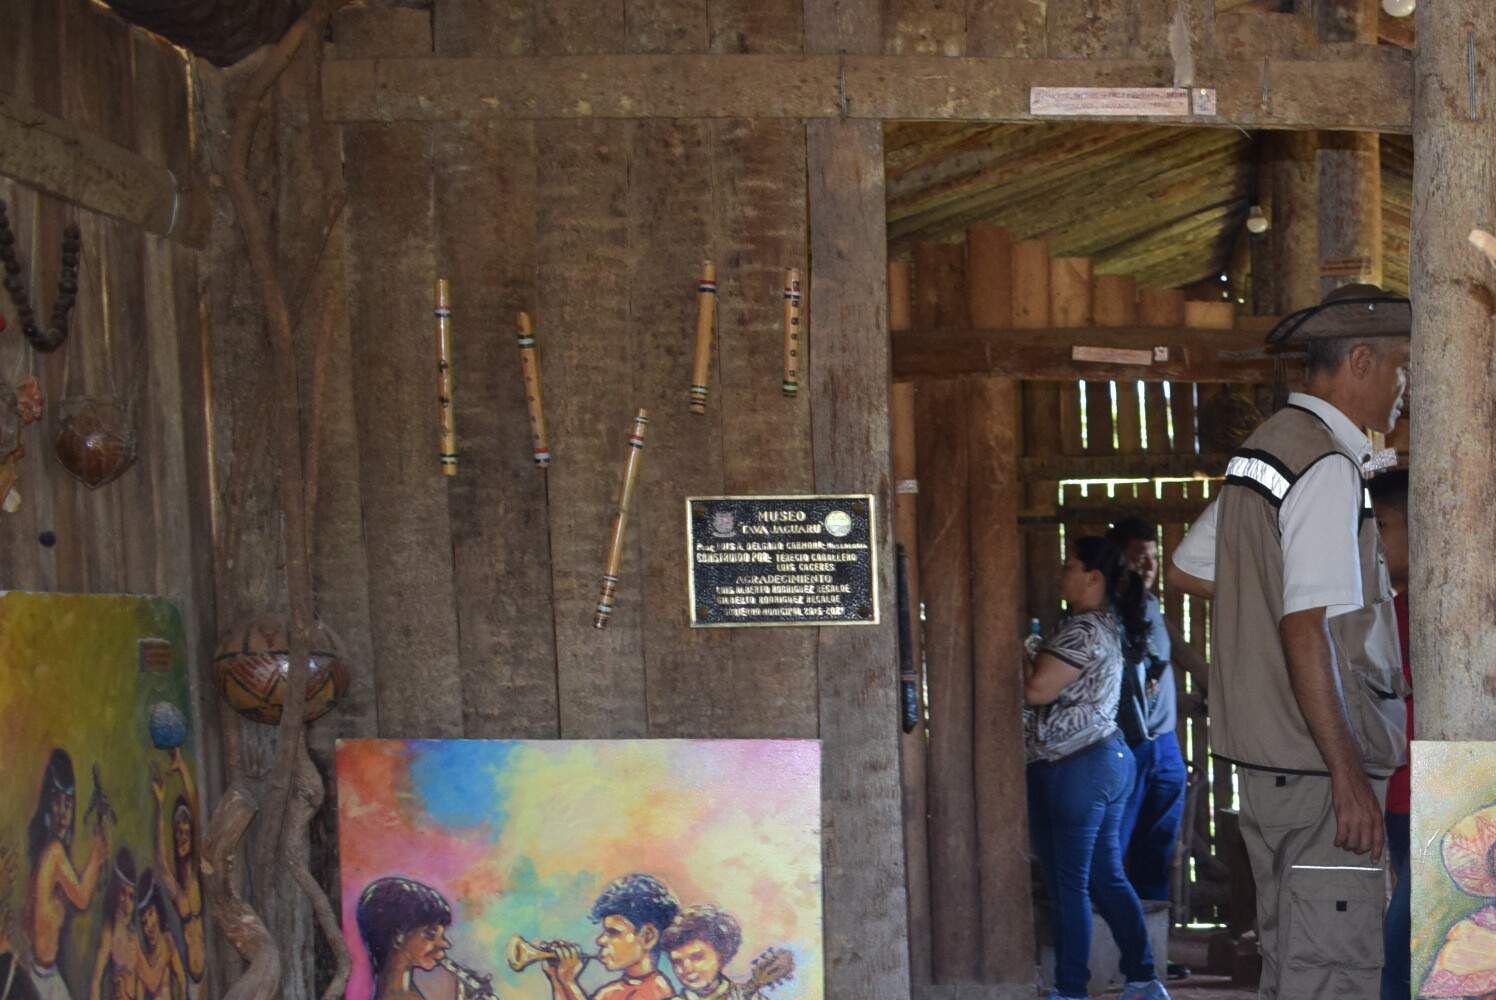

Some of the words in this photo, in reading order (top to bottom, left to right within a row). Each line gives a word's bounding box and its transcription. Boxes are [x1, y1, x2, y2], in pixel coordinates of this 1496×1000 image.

[758, 511, 806, 521] MUSEO
[696, 552, 750, 563] CONSTRUIDO
[777, 563, 796, 572] LUIS
[736, 574, 833, 584] AGRADECIMIENTO
